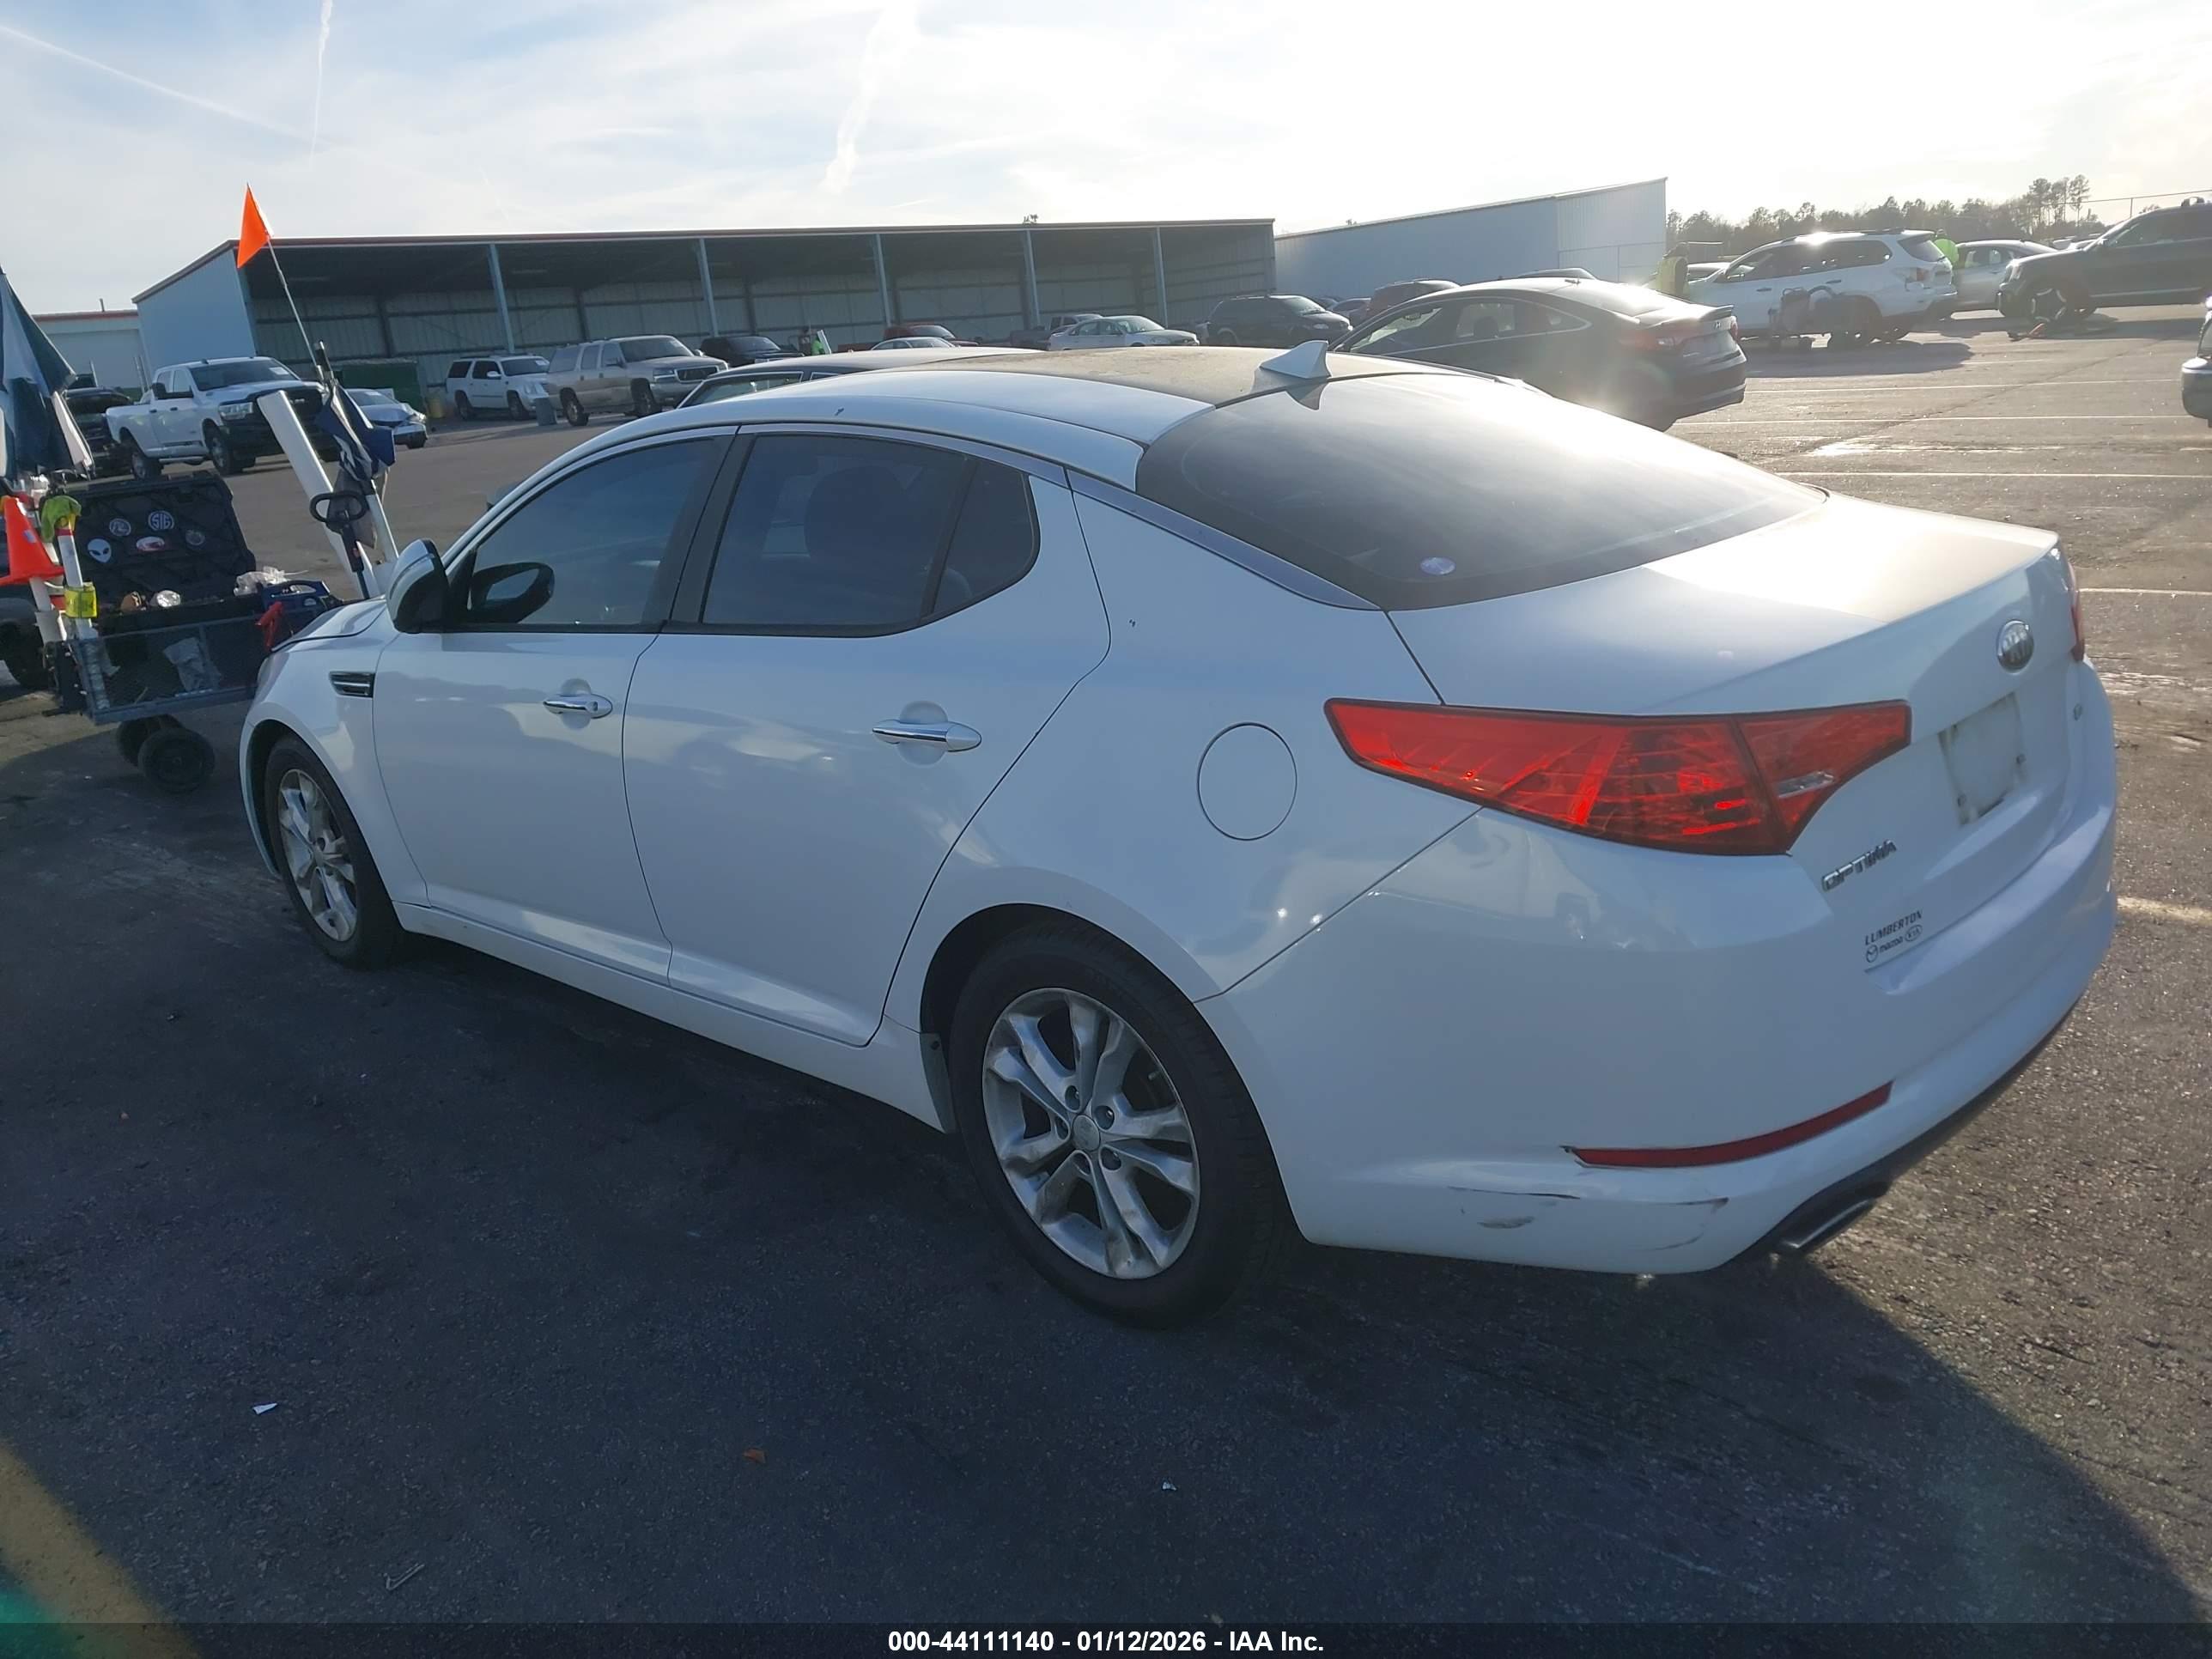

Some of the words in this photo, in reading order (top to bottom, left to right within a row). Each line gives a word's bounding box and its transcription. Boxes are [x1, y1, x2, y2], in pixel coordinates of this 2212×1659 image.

[150, 514, 173, 530] SIG
[1821, 839, 1897, 892] OPTIMA
[1865, 910, 1922, 945] LUMBERTON
